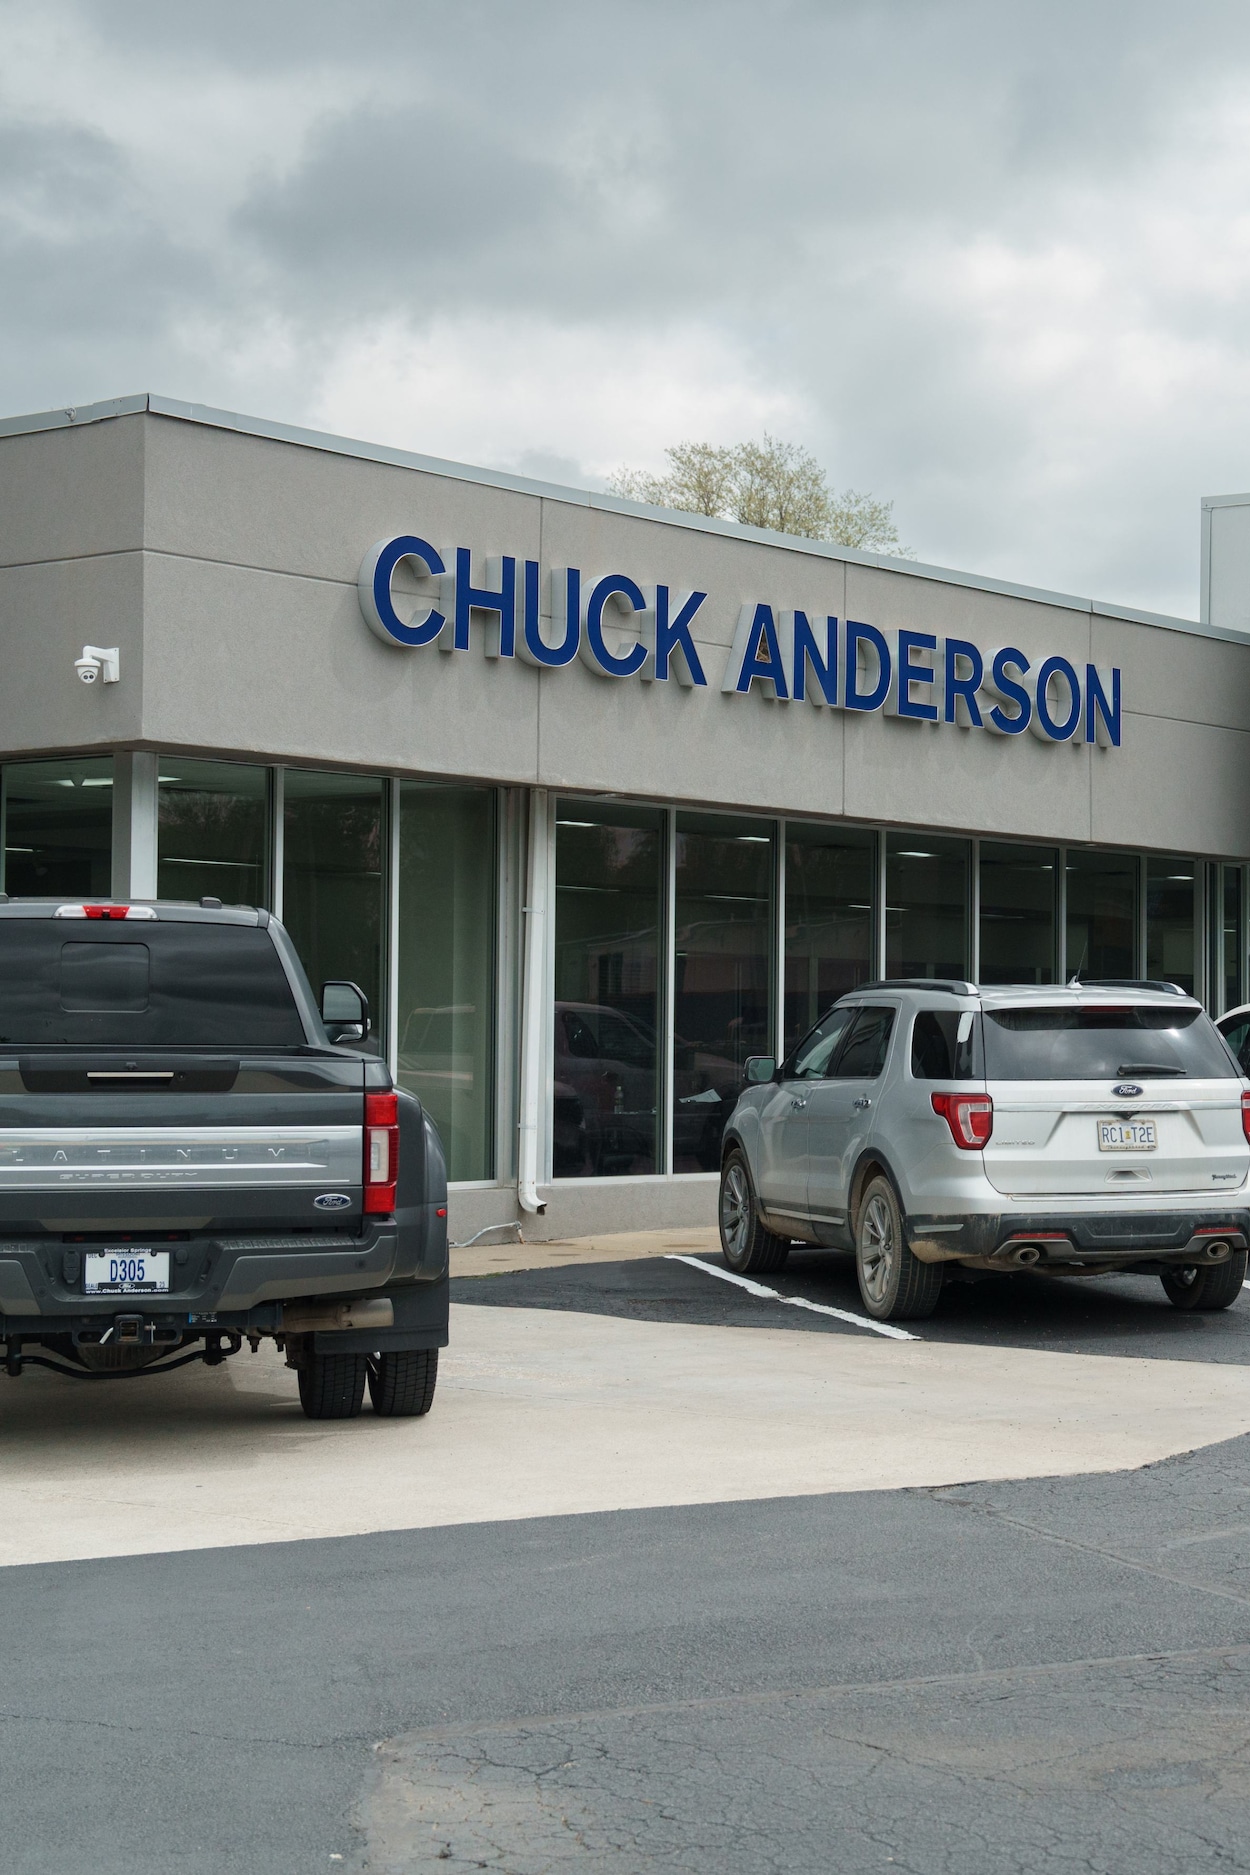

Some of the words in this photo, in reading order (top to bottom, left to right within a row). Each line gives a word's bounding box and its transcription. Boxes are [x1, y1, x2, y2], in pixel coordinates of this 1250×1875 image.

[360, 533, 709, 687] CHUCK
[724, 602, 1122, 748] ANDERSON
[1102, 1126, 1125, 1143] RC1
[1130, 1126, 1155, 1143] T2E
[110, 1259, 145, 1282] D305
